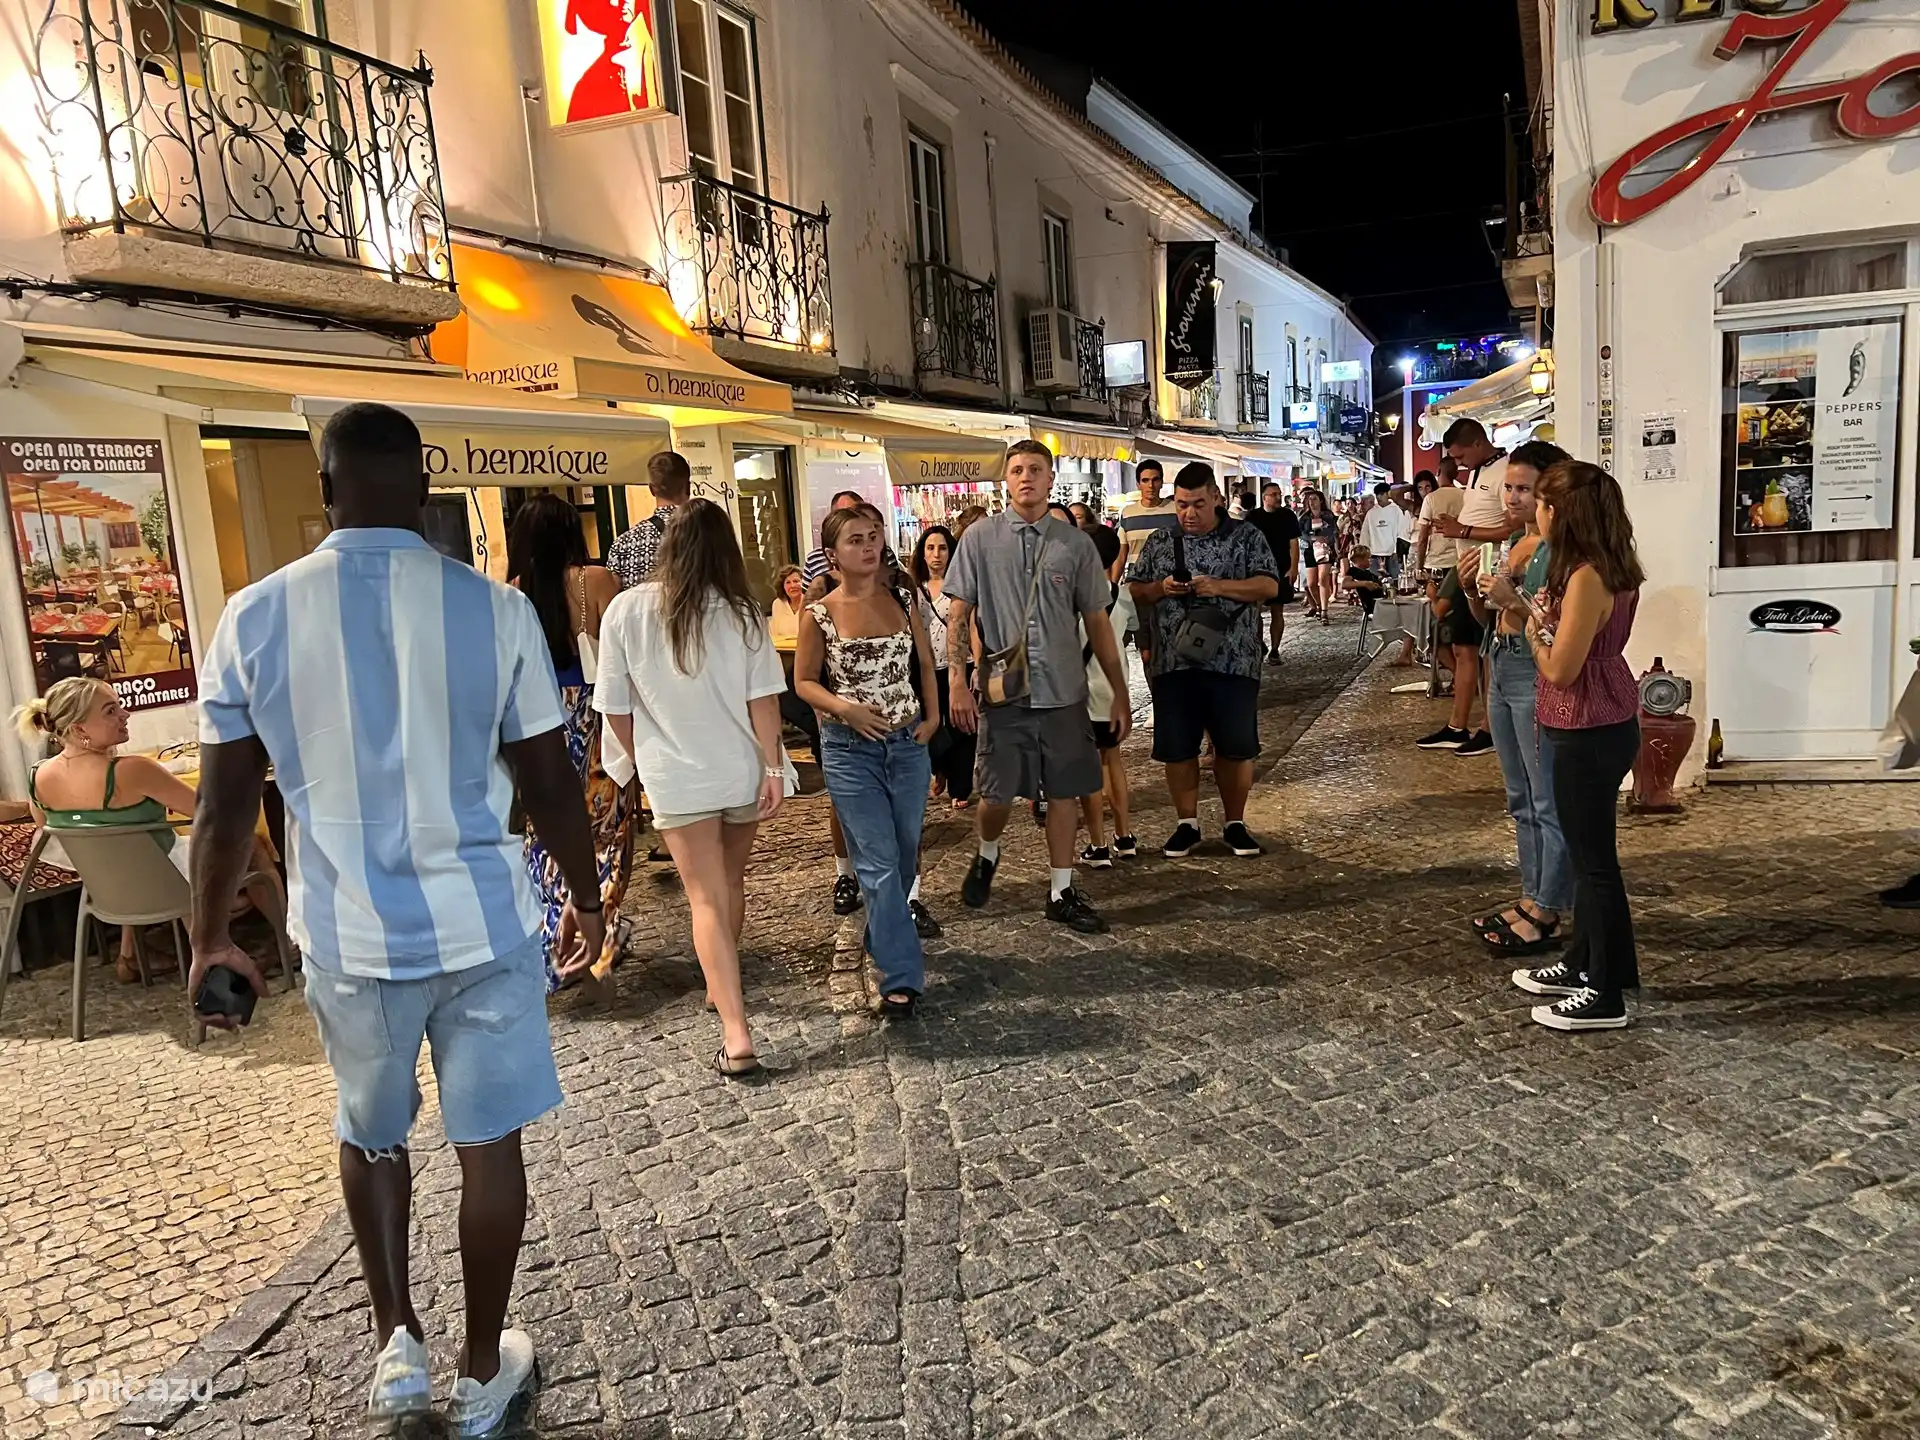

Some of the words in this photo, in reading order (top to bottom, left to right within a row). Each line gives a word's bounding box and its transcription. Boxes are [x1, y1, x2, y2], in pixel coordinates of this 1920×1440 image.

[1178, 356, 1199, 365] PIZZA
[1177, 364, 1200, 372] PASTA
[667, 371, 745, 405] henrique
[1825, 402, 1882, 414] PEPPERS
[1843, 418, 1863, 427] BAR
[10, 442, 54, 456] OPEN
[57, 443, 84, 456] AIR
[87, 444, 154, 457] TERRACE
[23, 459, 60, 471] OPEN
[63, 459, 91, 471] FOR
[94, 459, 146, 471] DINNERS
[464, 438, 609, 482] henrique
[933, 457, 981, 480] henrique
[1758, 607, 1789, 620] Tutti
[135, 686, 190, 706] JANTARES
